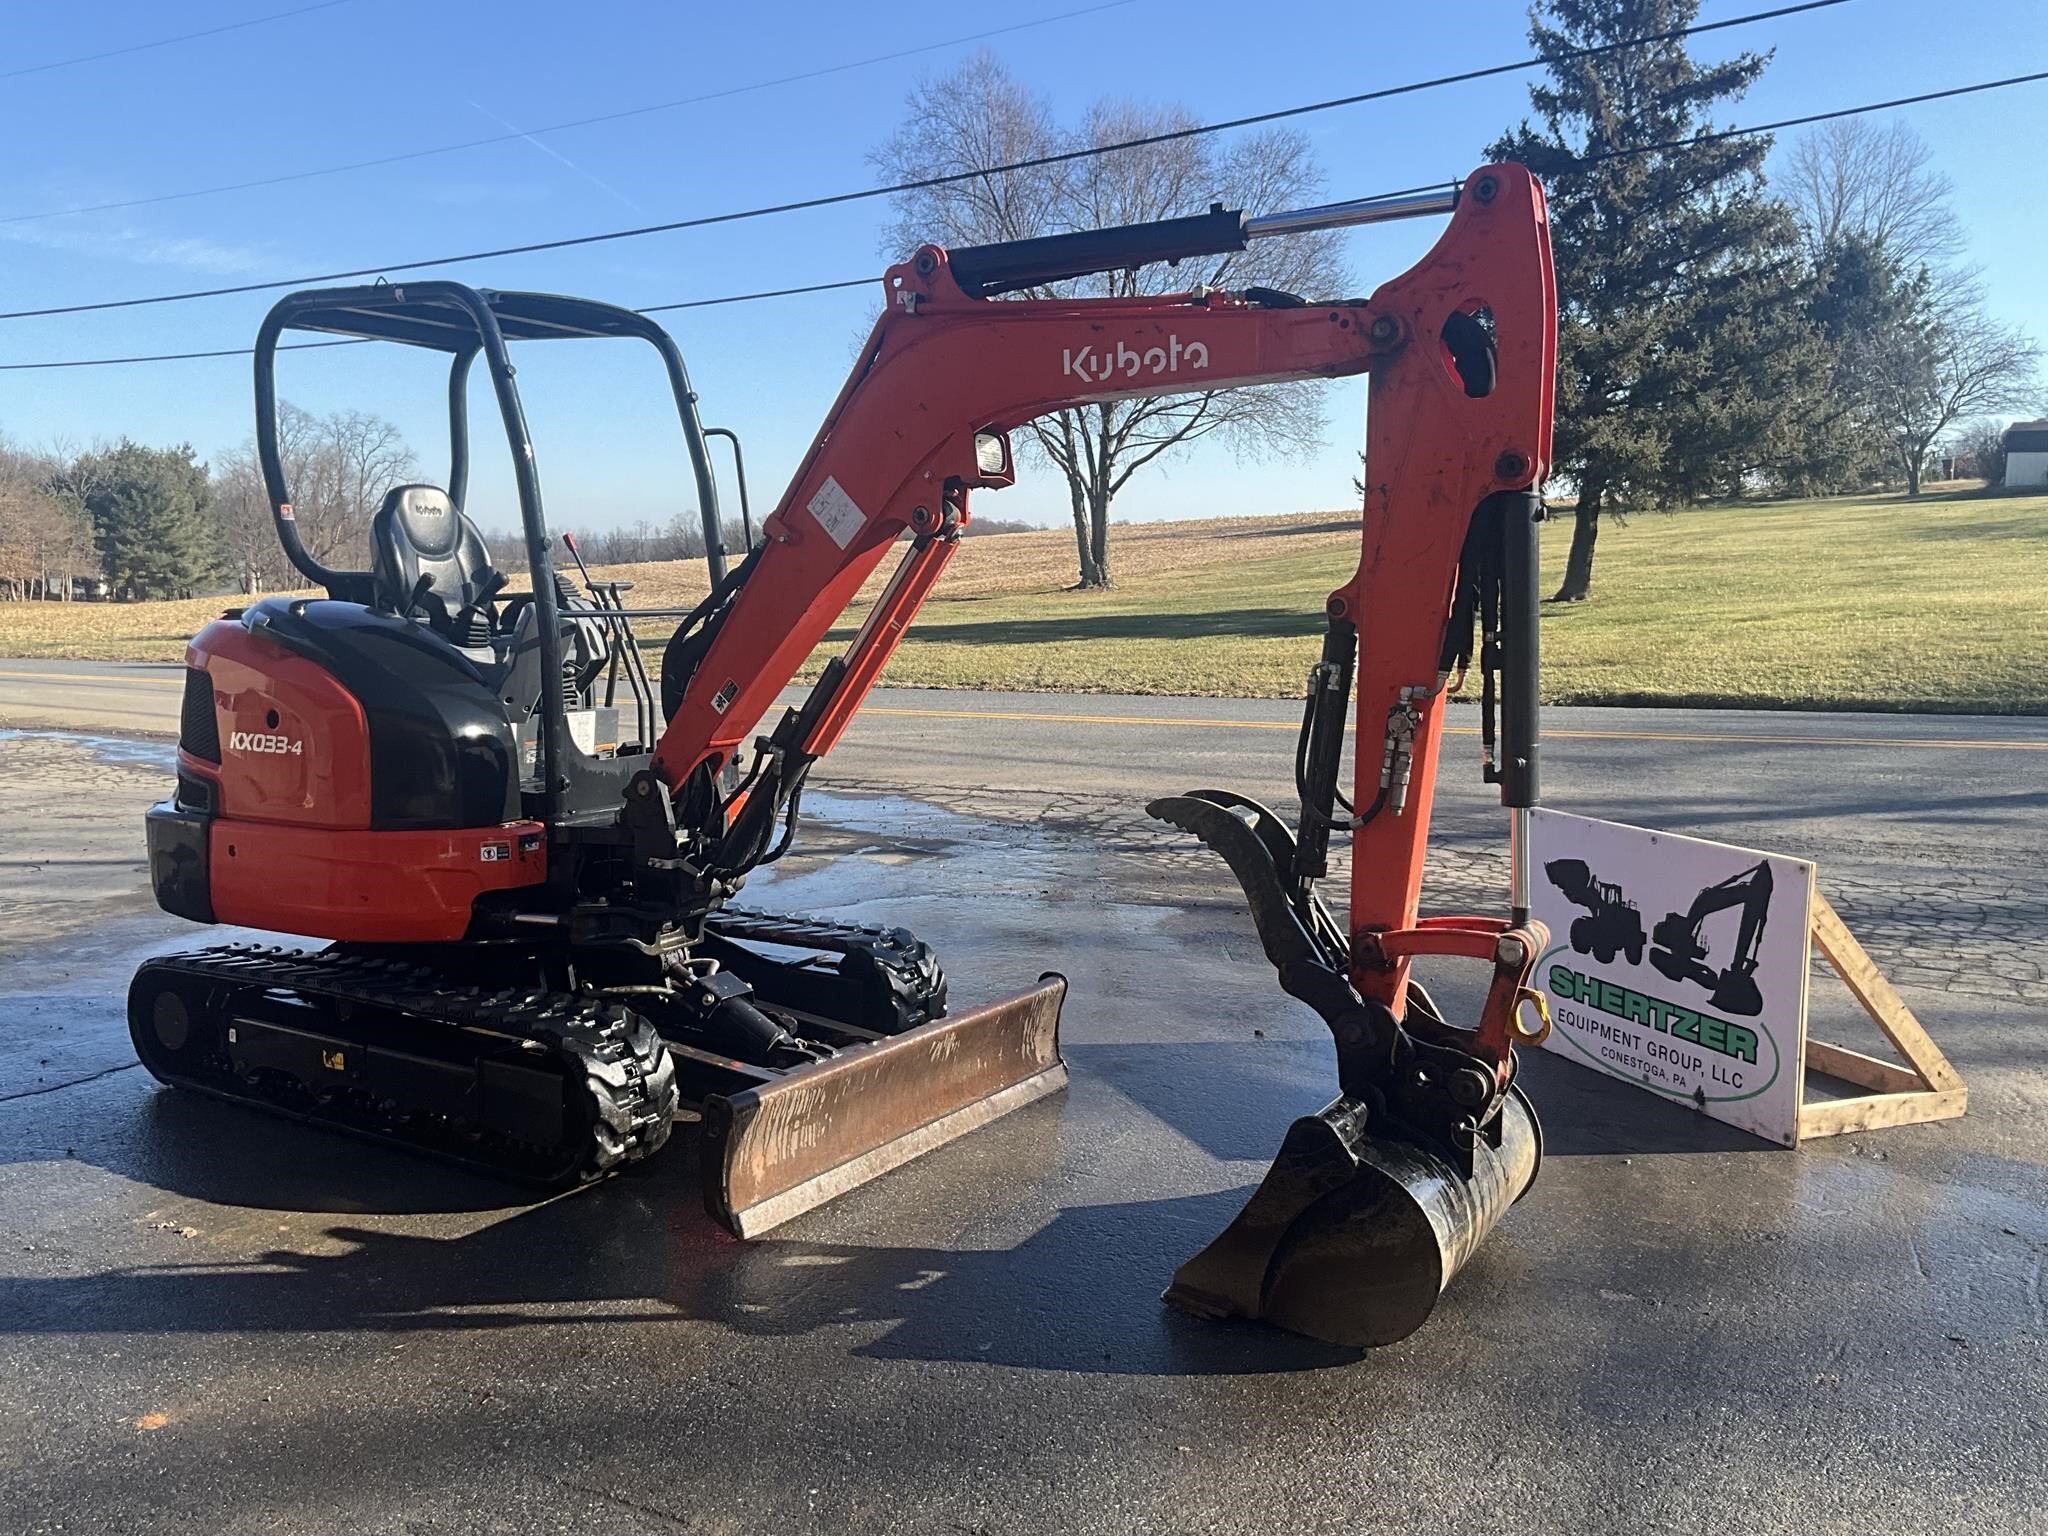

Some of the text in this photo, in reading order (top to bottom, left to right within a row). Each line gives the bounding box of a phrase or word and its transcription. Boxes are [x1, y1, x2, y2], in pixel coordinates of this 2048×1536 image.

[1063, 334, 1209, 383] Kubota
[229, 731, 303, 756] KX033-4
[1549, 964, 1758, 1065] SHERTZER
[1558, 1008, 1743, 1089] EQUIPMENT GROUP, LLC
[1601, 1046, 1687, 1088] CONESTOGA, PA
